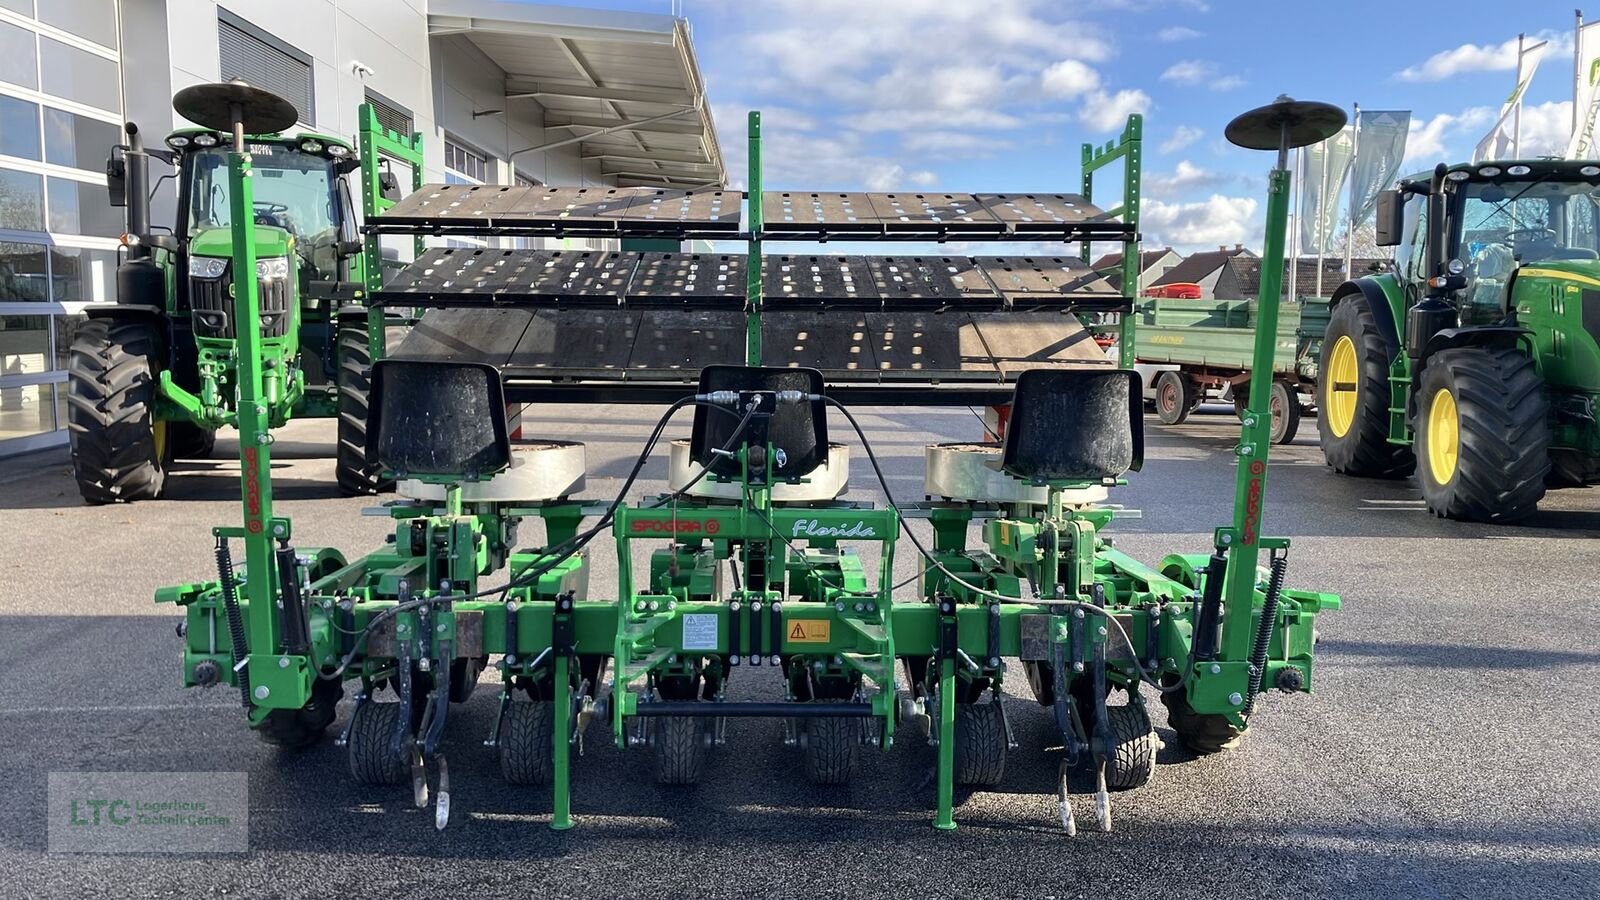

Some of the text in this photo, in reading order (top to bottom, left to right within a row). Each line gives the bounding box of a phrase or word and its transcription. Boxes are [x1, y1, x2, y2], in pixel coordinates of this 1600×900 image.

[244, 447, 259, 516] SFOGGIA
[632, 519, 702, 533] SFOGGIA
[792, 519, 876, 537] Florida
[1242, 479, 1260, 545] SFOGGIA
